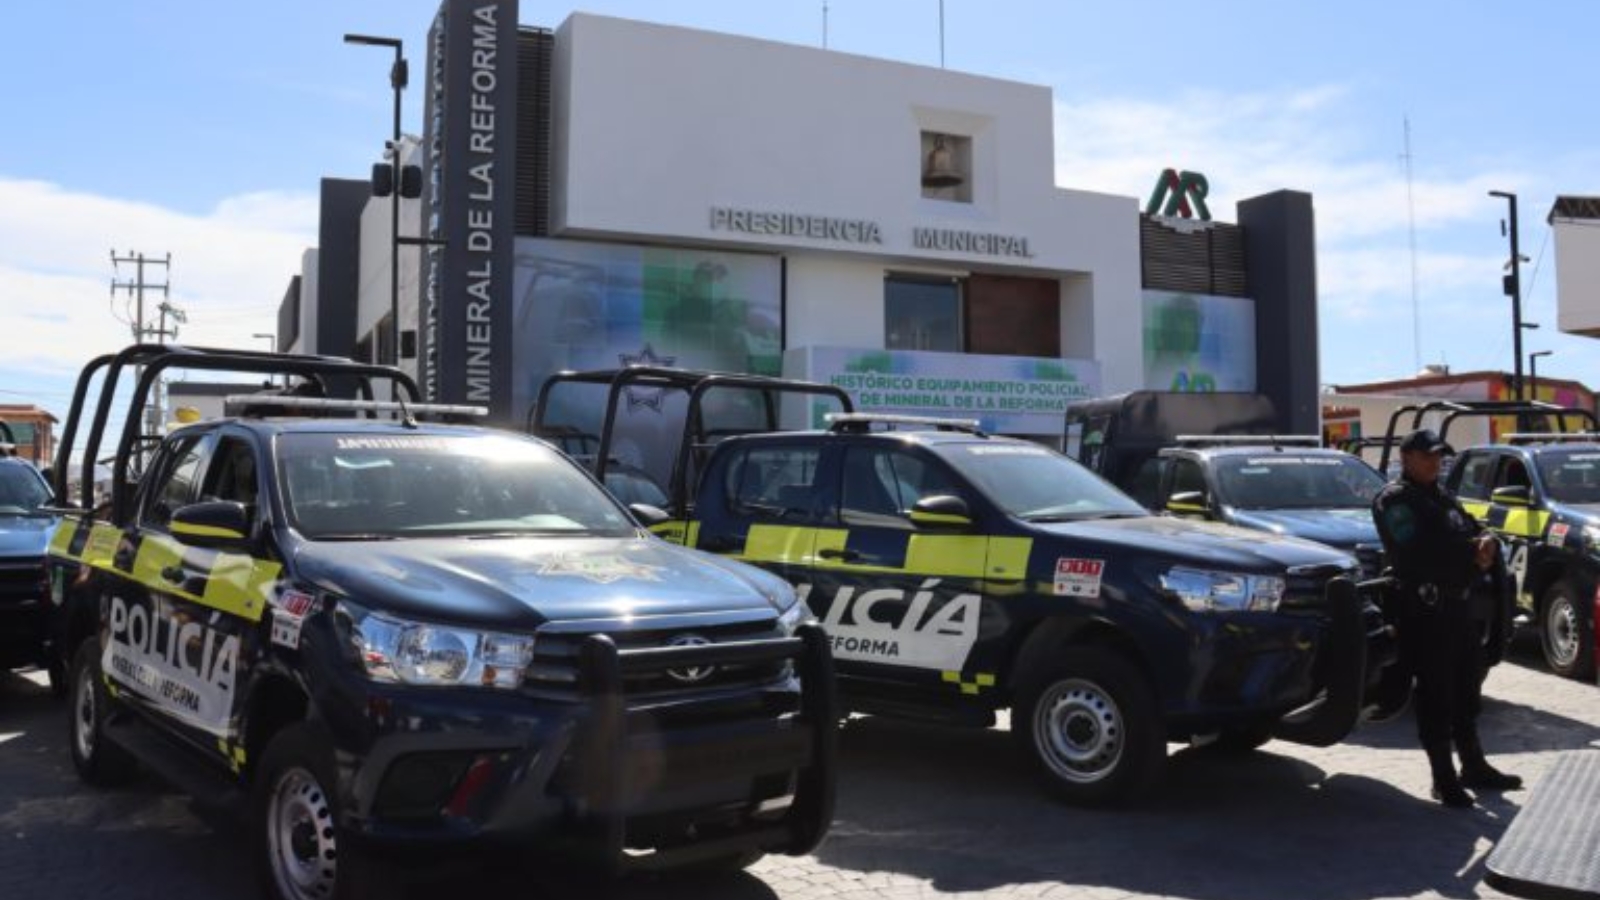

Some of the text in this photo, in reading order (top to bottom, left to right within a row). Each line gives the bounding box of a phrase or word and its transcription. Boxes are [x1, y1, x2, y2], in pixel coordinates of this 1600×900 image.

[466, 4, 499, 401] MINERAL DE LA REFORMA
[709, 206, 1035, 258] PRESIDENCIA MUNICIPAL
[831, 372, 914, 390] HISTÓRICO
[916, 377, 1026, 395] EQUIPAMIENTO
[860, 393, 882, 406] DE
[885, 393, 950, 407] MINERAL
[953, 396, 973, 409] DE
[977, 397, 995, 409] LA
[110, 597, 241, 691] POLICÍA
